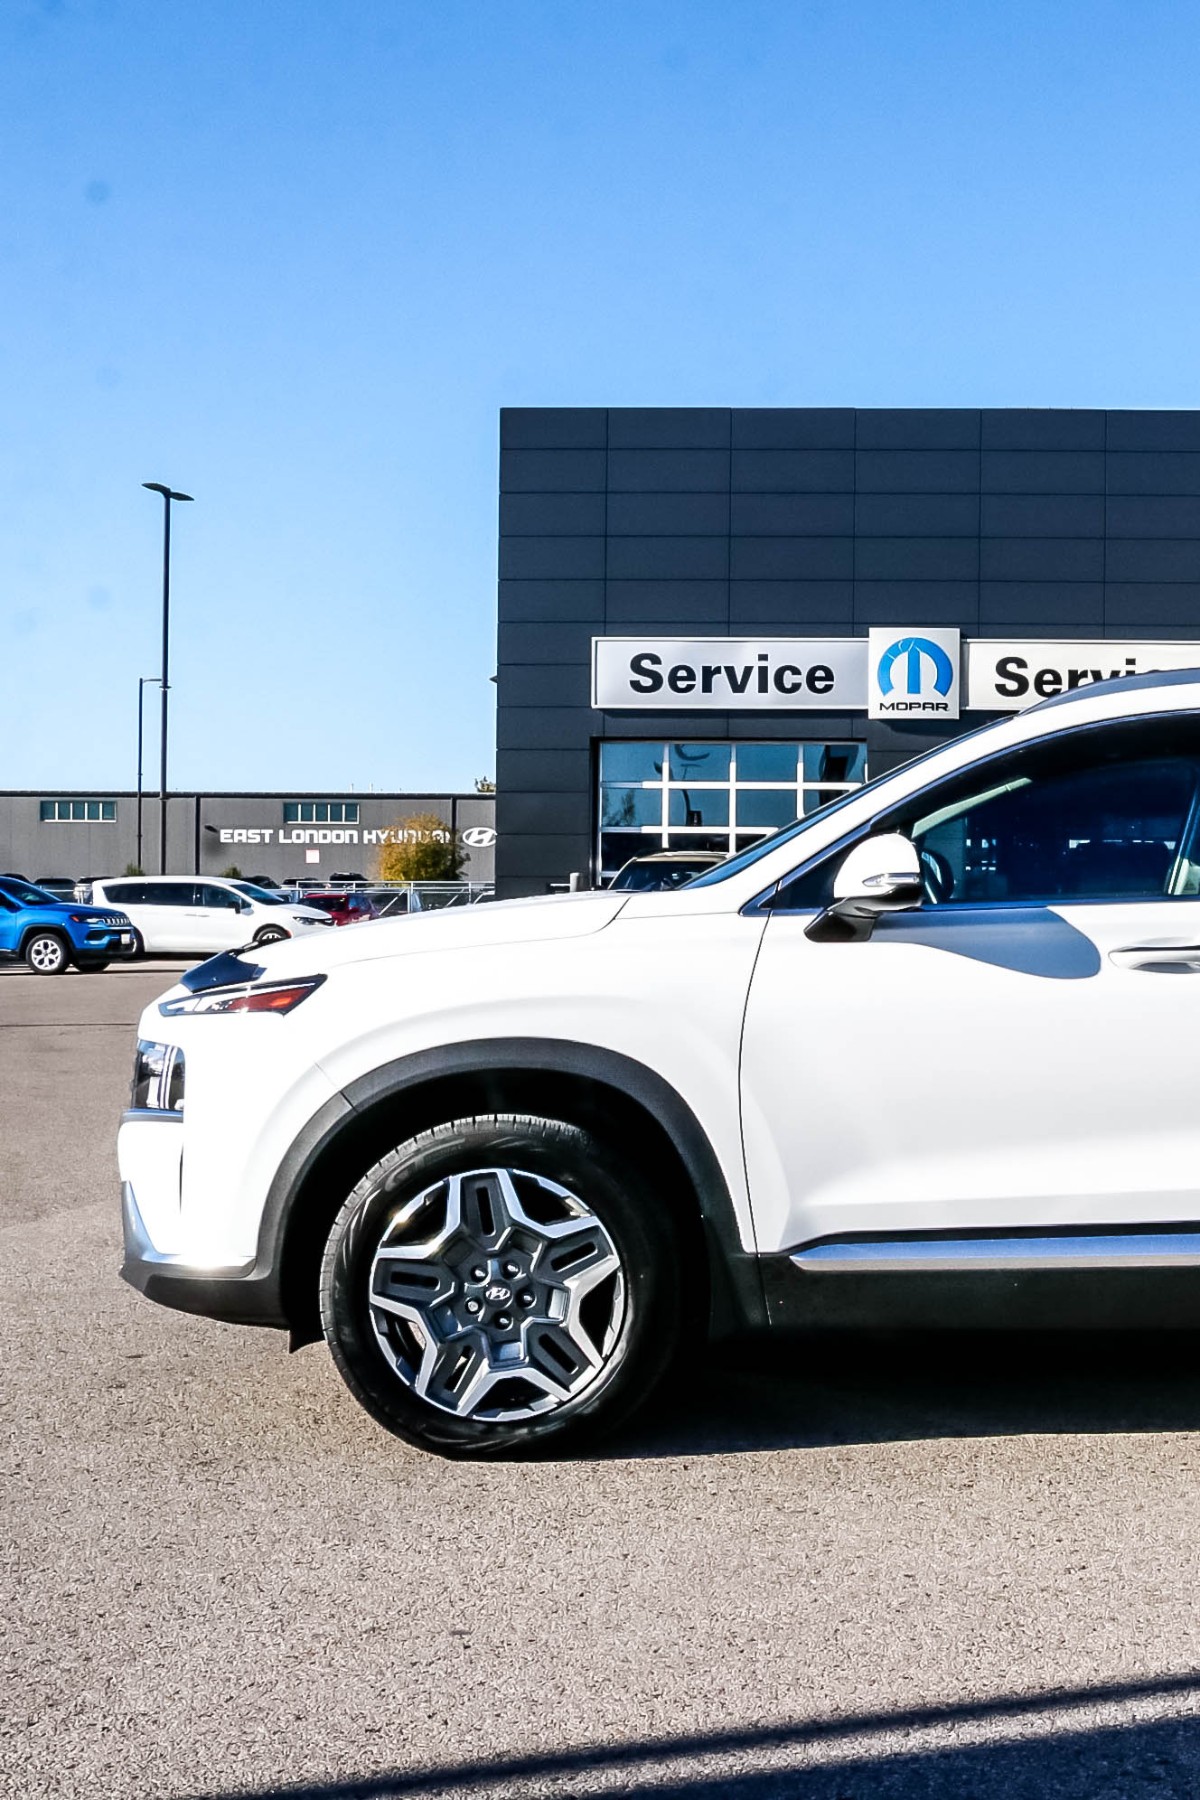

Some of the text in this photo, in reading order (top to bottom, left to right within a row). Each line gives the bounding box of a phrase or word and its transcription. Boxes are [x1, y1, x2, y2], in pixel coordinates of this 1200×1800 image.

[629, 652, 835, 695] Service
[879, 701, 950, 712] MOPAR
[219, 829, 274, 844] EAST
[278, 829, 359, 844] LONDON
